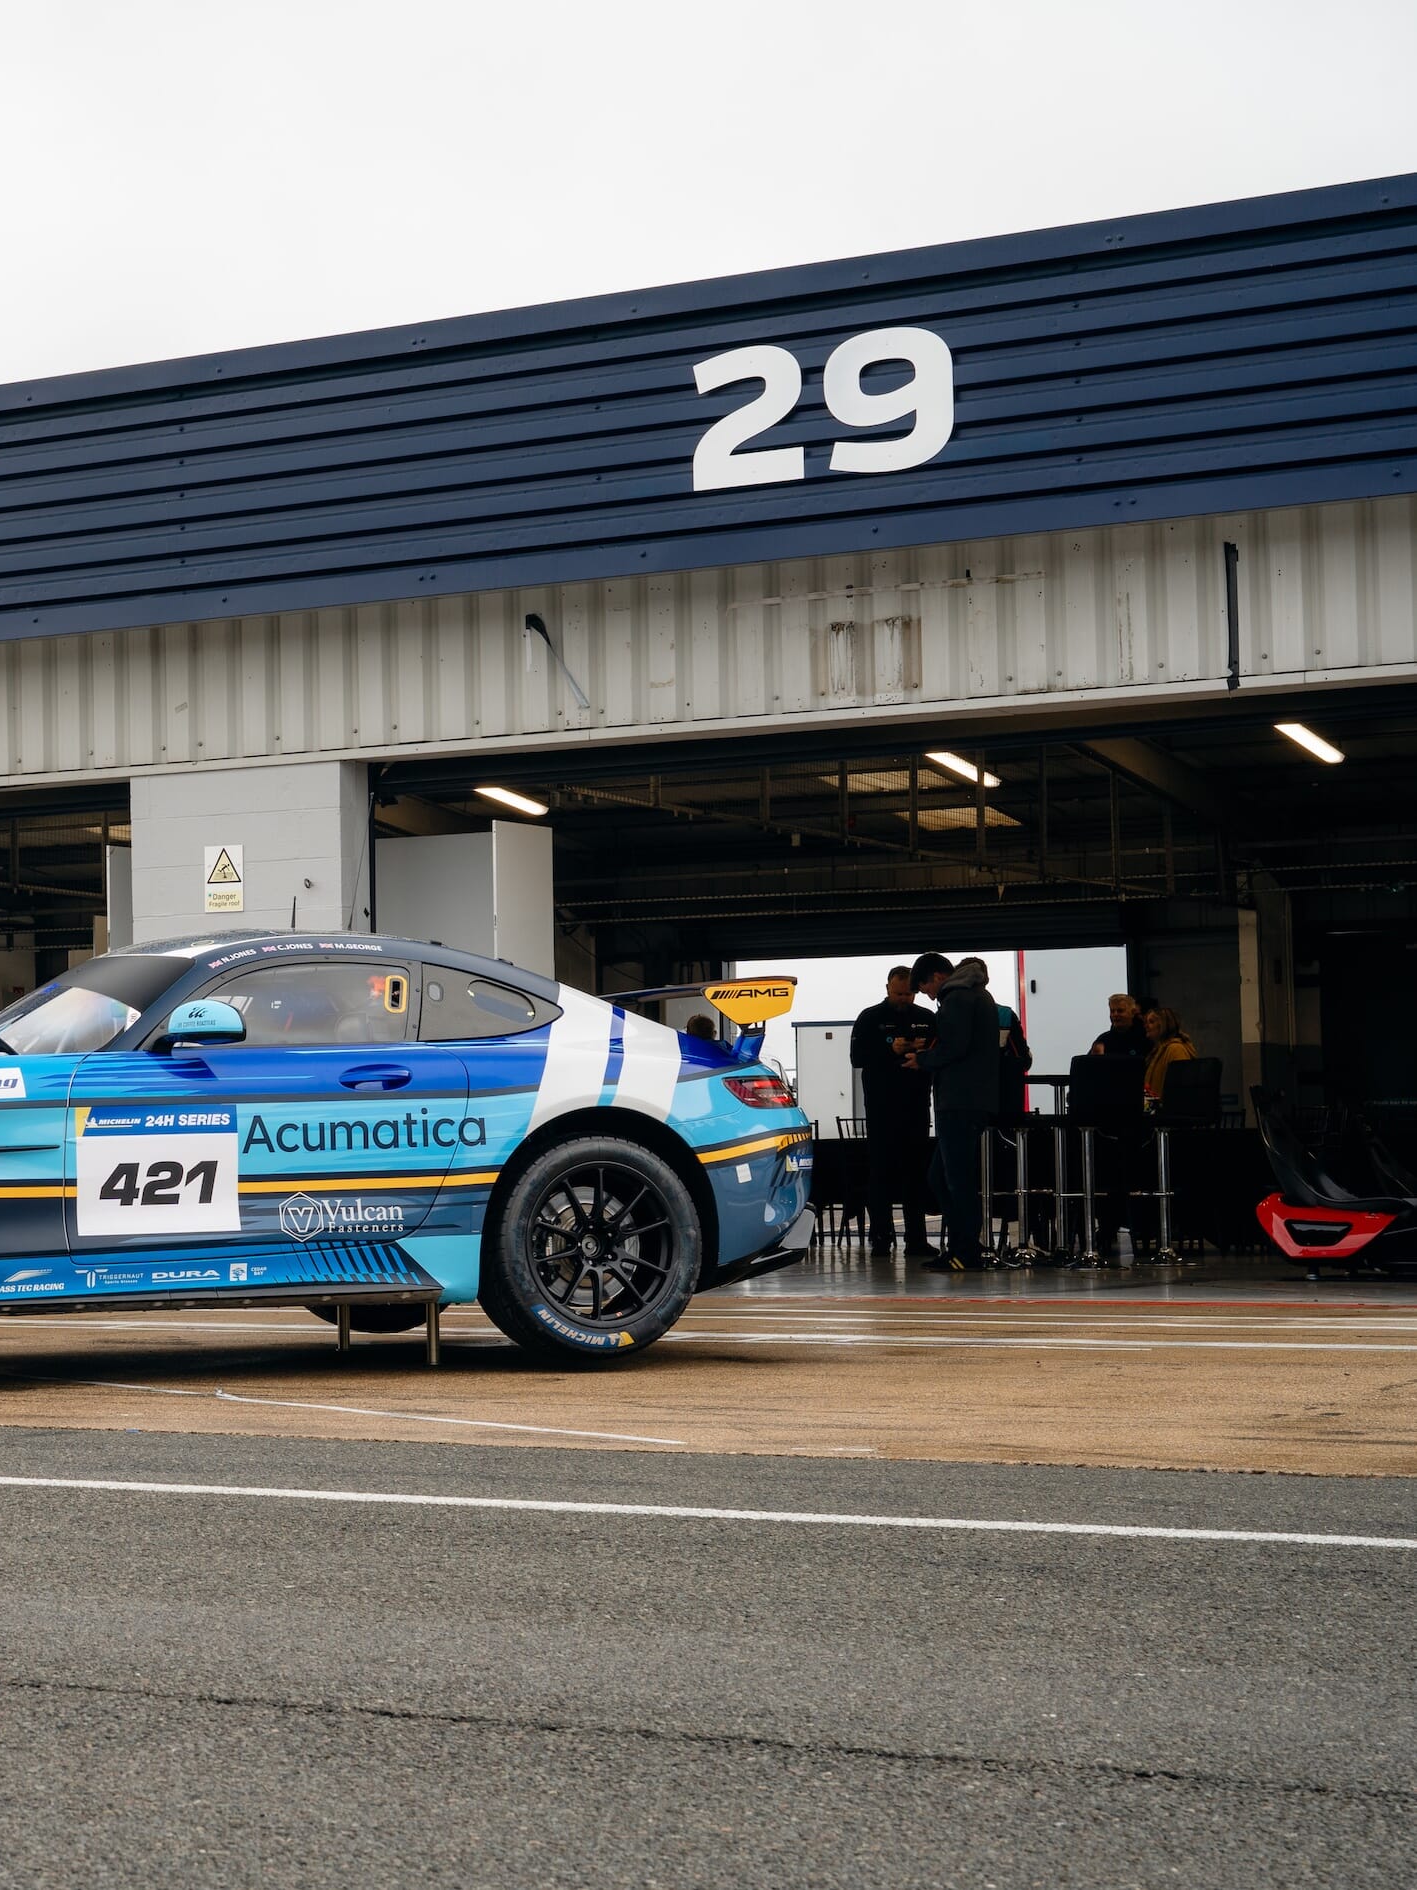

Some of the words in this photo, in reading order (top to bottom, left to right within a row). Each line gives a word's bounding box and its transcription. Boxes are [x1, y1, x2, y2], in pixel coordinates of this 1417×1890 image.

[693, 327, 954, 491] 29
[212, 893, 237, 902] Danger
[277, 943, 314, 951] C.JONES
[334, 943, 383, 952] M.GEORGE
[221, 949, 257, 965] N.JONES
[735, 987, 789, 999] AMG
[144, 1115, 175, 1127] 24H
[178, 1113, 231, 1126] SERIES
[242, 1108, 487, 1154] Acumatica
[99, 1160, 219, 1207] 421
[321, 1199, 405, 1222] Vulcan
[327, 1221, 405, 1234] Fasteners
[99, 1272, 144, 1280] TRIGGERNAUT
[152, 1269, 220, 1280] DURA
[17, 1284, 31, 1293] TEC
[33, 1283, 65, 1292] RACING
[537, 1309, 606, 1346] MICHELIN
